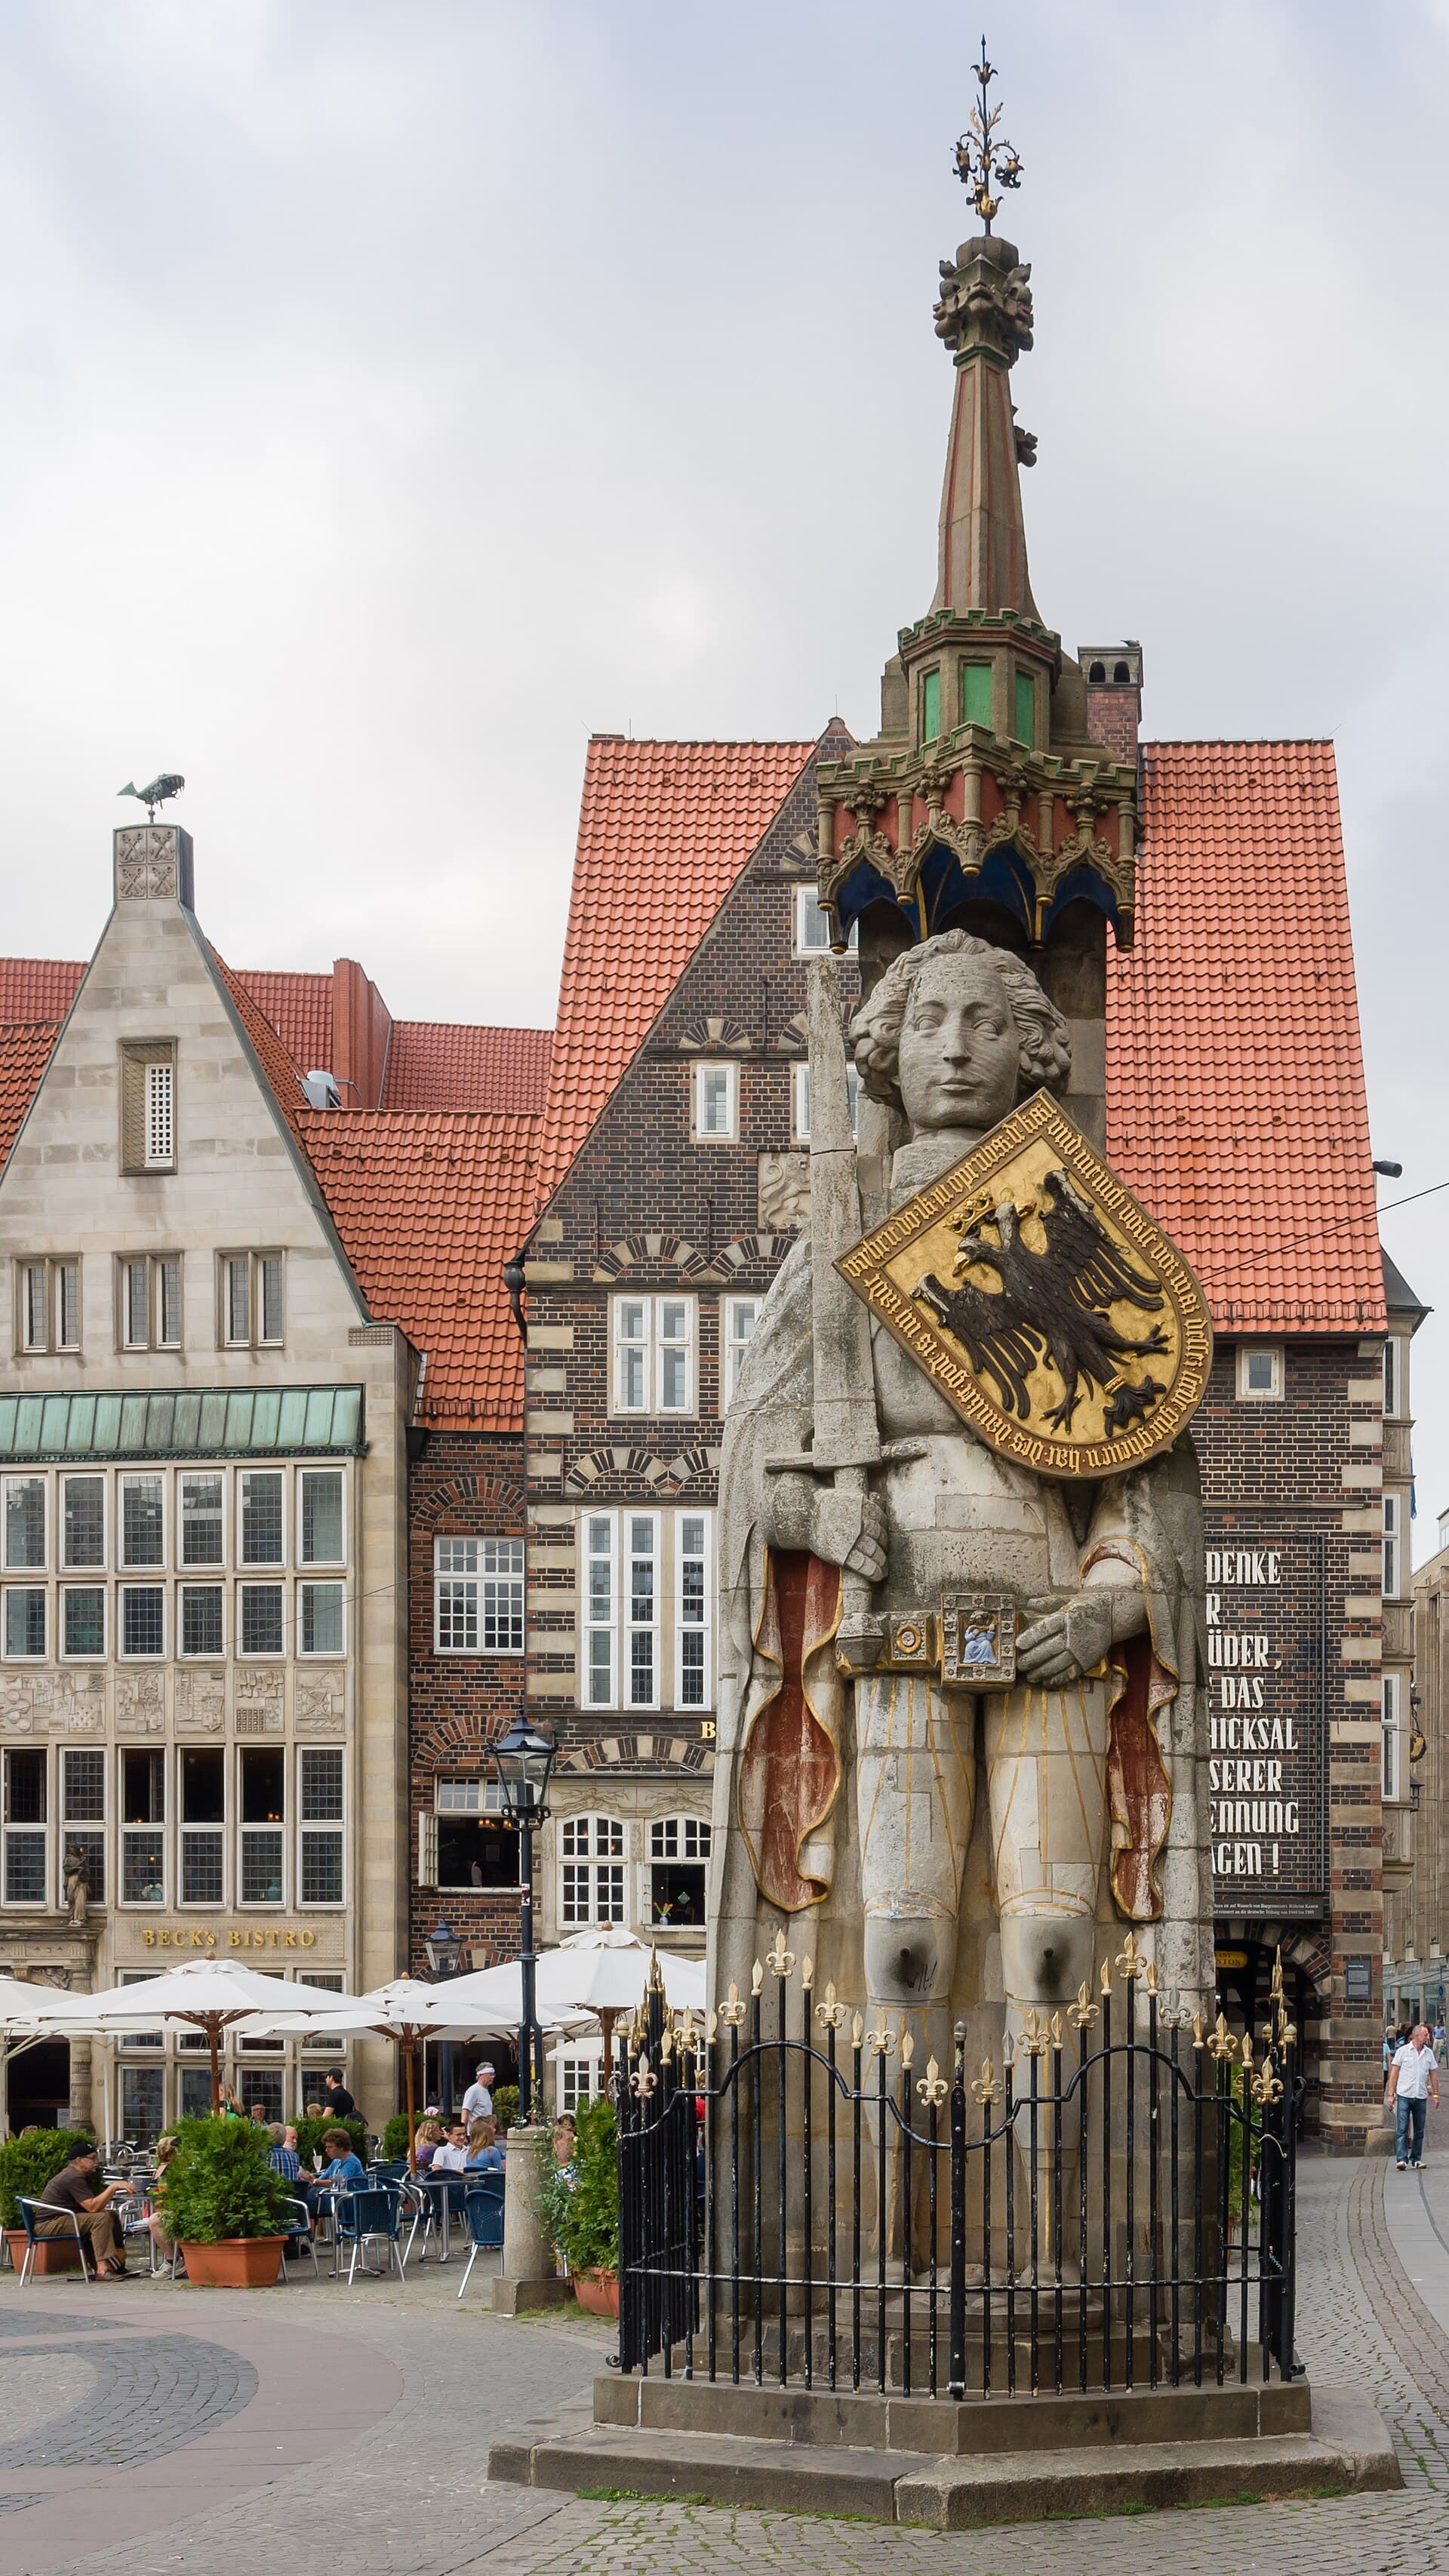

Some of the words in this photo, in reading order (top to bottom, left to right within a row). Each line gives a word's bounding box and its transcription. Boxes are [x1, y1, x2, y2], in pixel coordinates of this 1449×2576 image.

[1206, 1552, 1281, 1583] DENKE
[1221, 1676, 1264, 1708] DAS
[700, 1721, 716, 1739] B
[1209, 1759, 1281, 1791] SERER
[143, 1930, 216, 1946] BECK's
[227, 1930, 315, 1947] BISTRO
